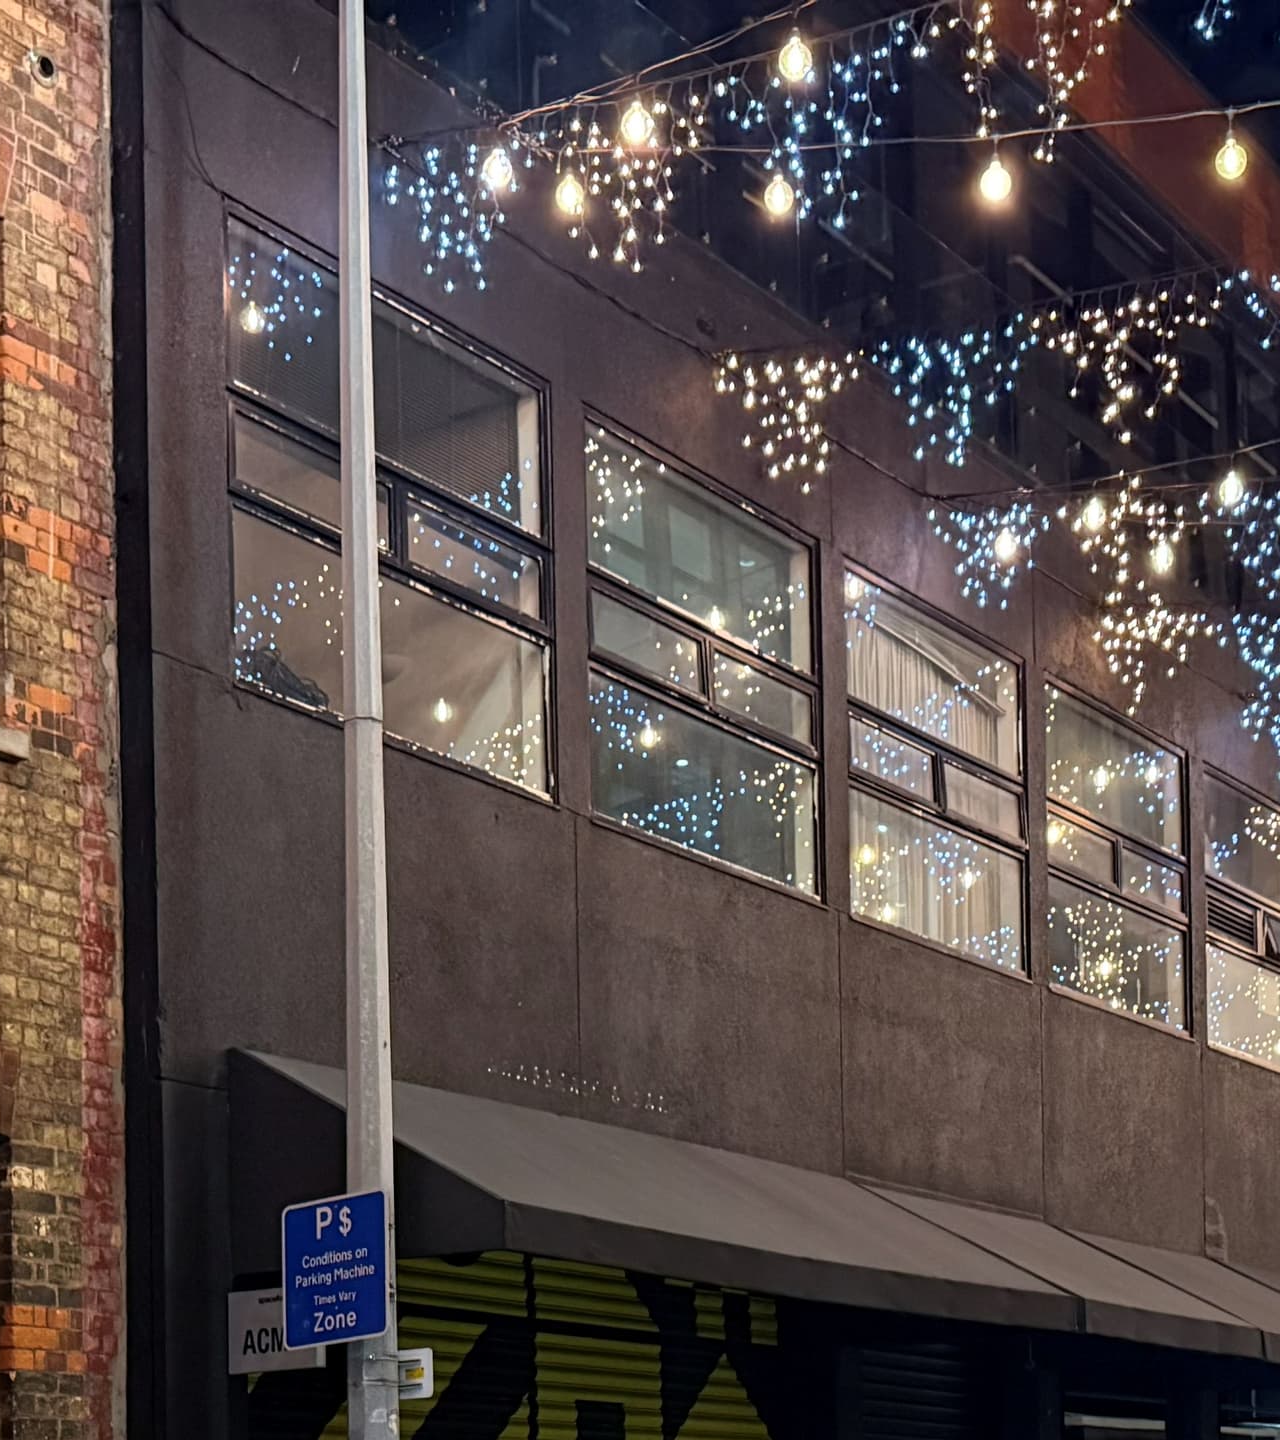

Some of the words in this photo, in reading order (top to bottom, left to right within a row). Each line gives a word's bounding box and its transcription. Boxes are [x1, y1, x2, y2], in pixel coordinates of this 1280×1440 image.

[315, 1206, 333, 1240] P
[339, 1206, 352, 1237] $
[302, 1249, 352, 1269] Conditions
[355, 1247, 368, 1259] on
[295, 1274, 332, 1288] Parking
[334, 1264, 375, 1281] Machine
[313, 1294, 337, 1306] Times
[338, 1290, 357, 1304] Vary
[313, 1310, 357, 1334] Zone
[242, 1327, 285, 1355] ACM
